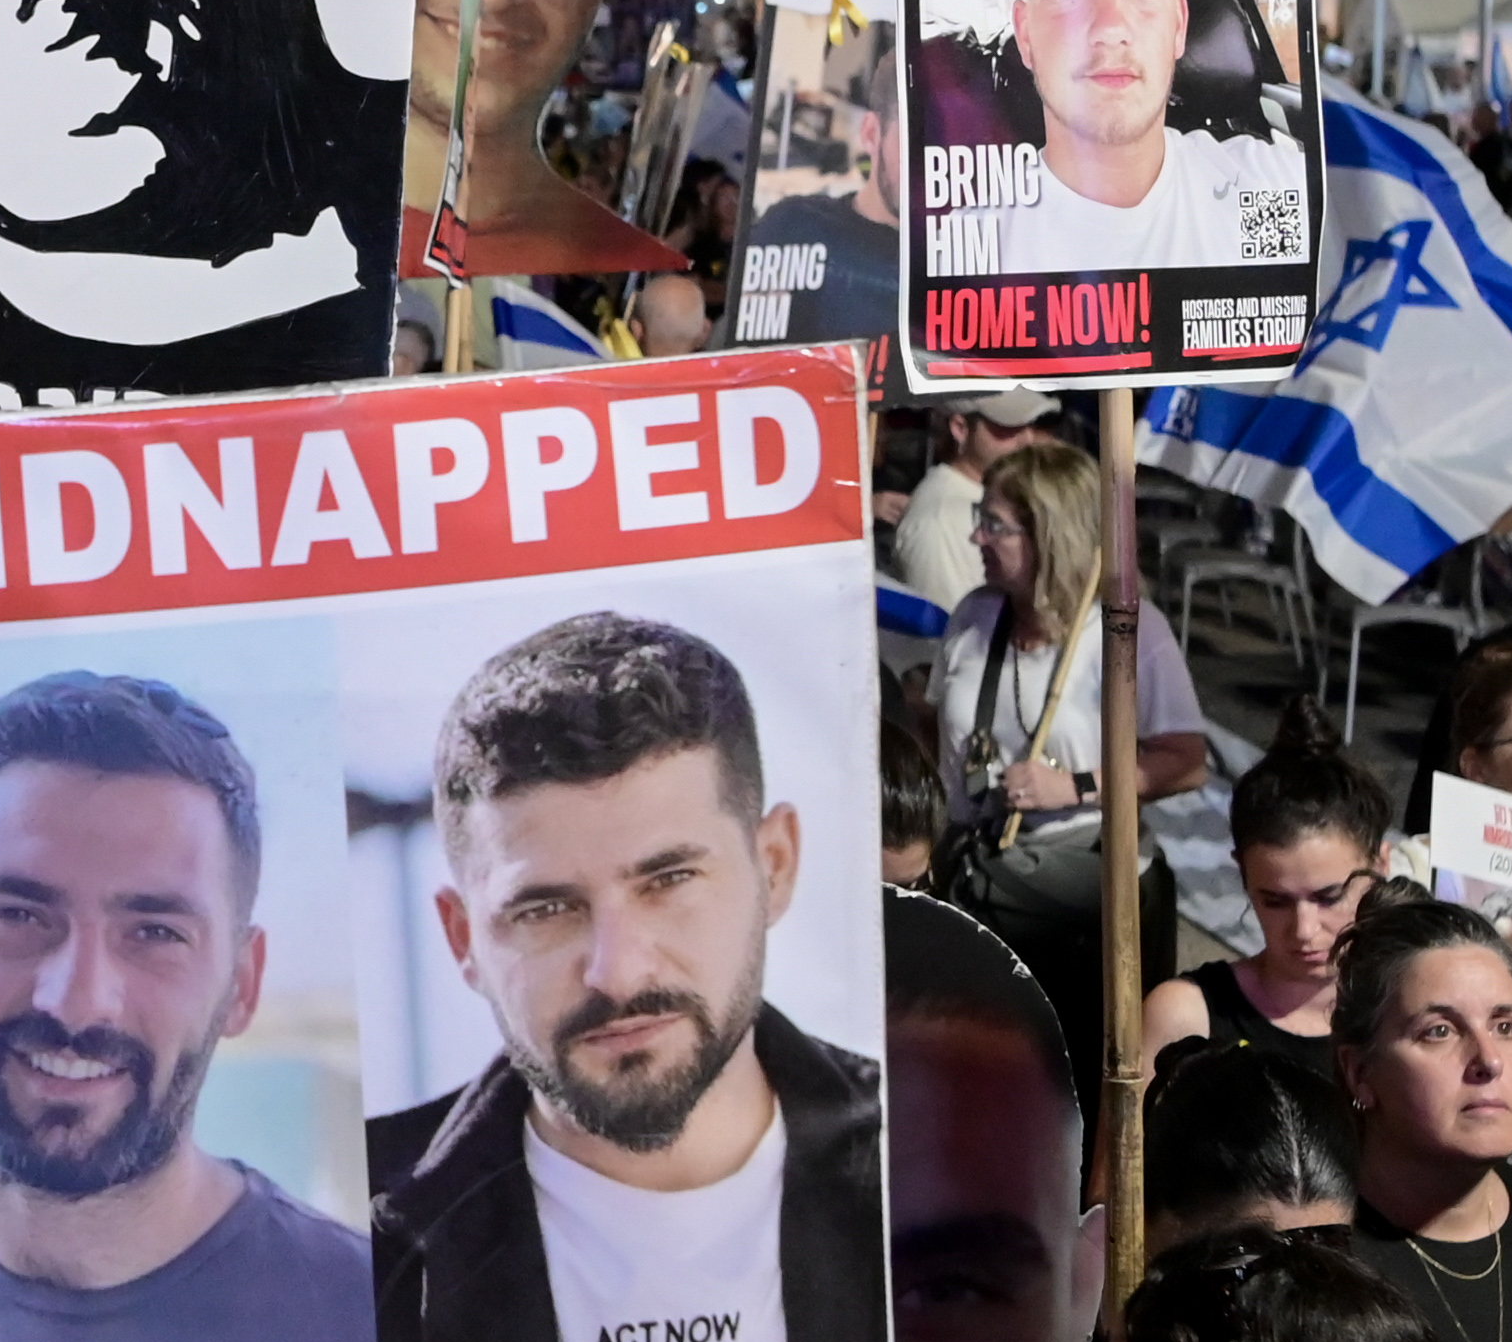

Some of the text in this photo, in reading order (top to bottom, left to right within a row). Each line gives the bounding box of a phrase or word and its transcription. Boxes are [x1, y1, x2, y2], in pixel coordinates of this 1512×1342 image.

[923, 142, 1041, 207] BRING
[742, 242, 827, 292] BRING
[925, 211, 1001, 277] HIM
[735, 292, 791, 342] HIM
[925, 272, 1153, 352] HOME NOW!
[1182, 295, 1307, 320] HOSTAGES AND MISSING
[1183, 316, 1306, 350] FAMILIES FORUM
